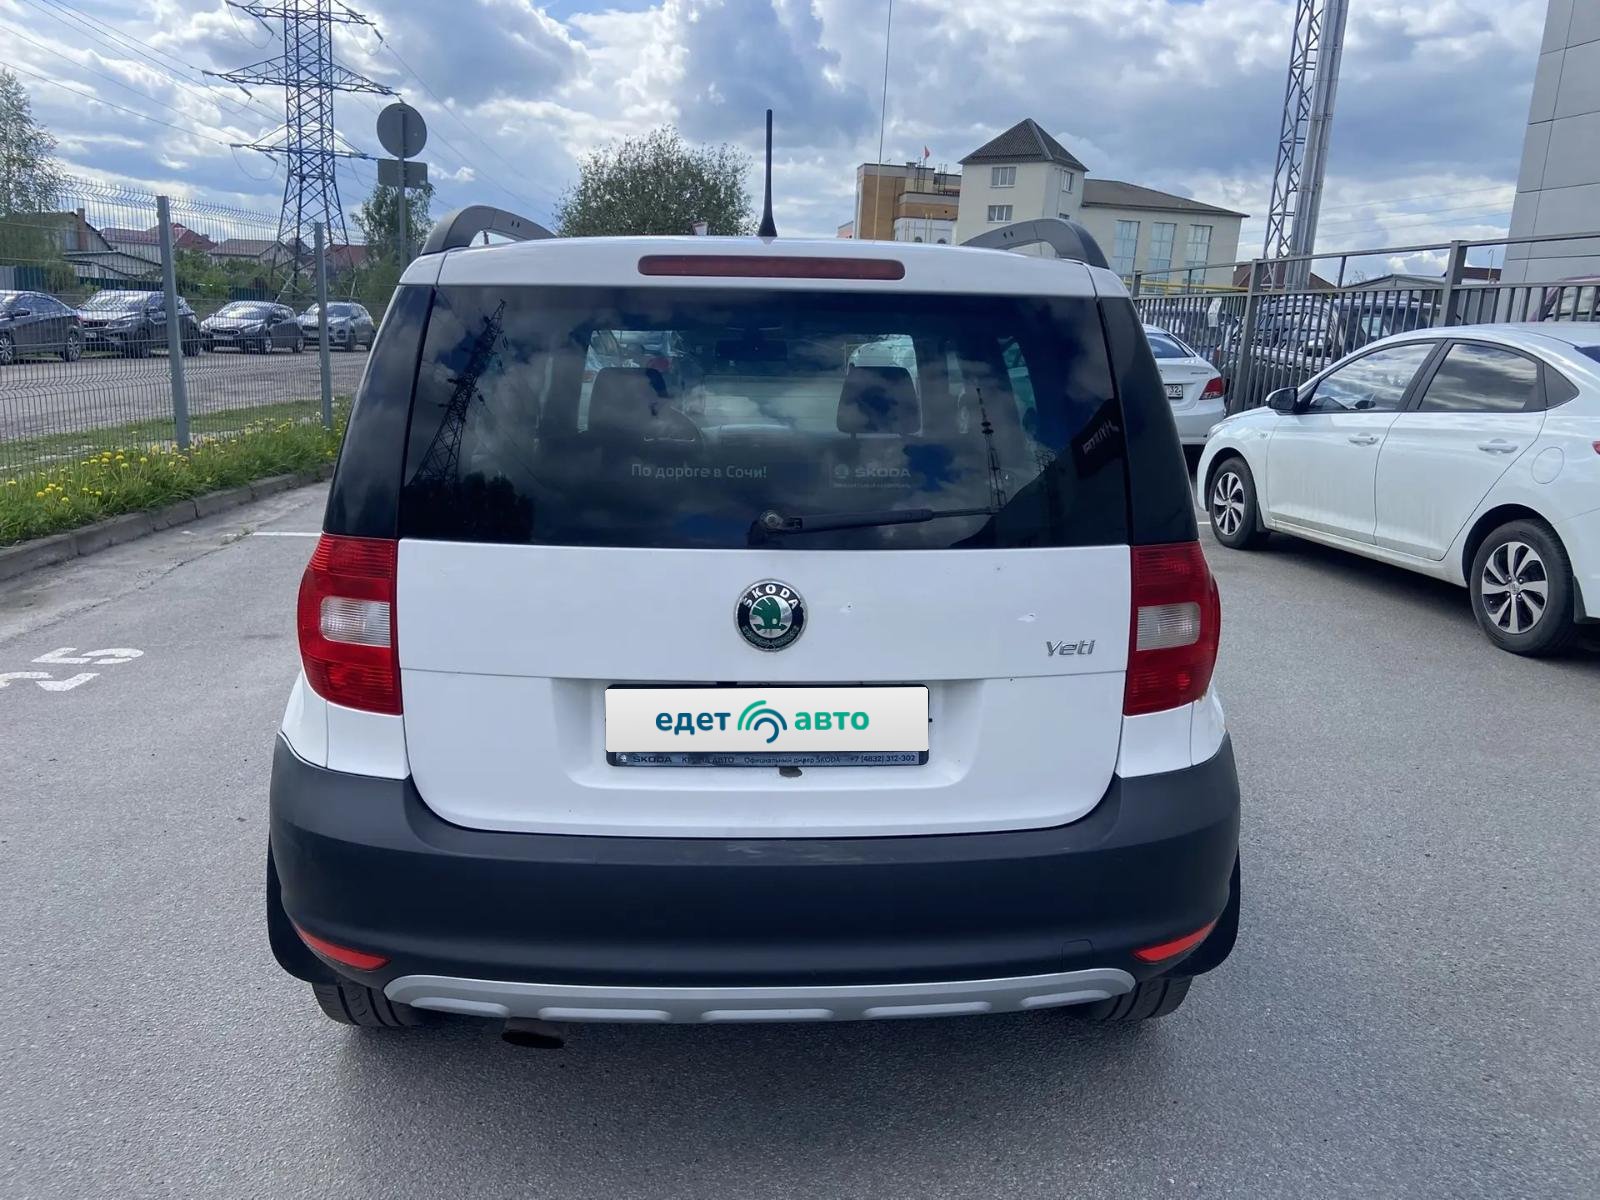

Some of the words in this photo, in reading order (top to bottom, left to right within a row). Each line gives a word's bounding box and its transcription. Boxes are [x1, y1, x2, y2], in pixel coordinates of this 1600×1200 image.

[631, 463, 651, 477] По
[655, 465, 711, 481] дороге
[713, 467, 722, 478] в
[726, 465, 768, 479] Сочи!
[742, 584, 799, 610] SKODA
[1046, 639, 1096, 656] Yeti
[886, 754, 916, 763] 312-302
